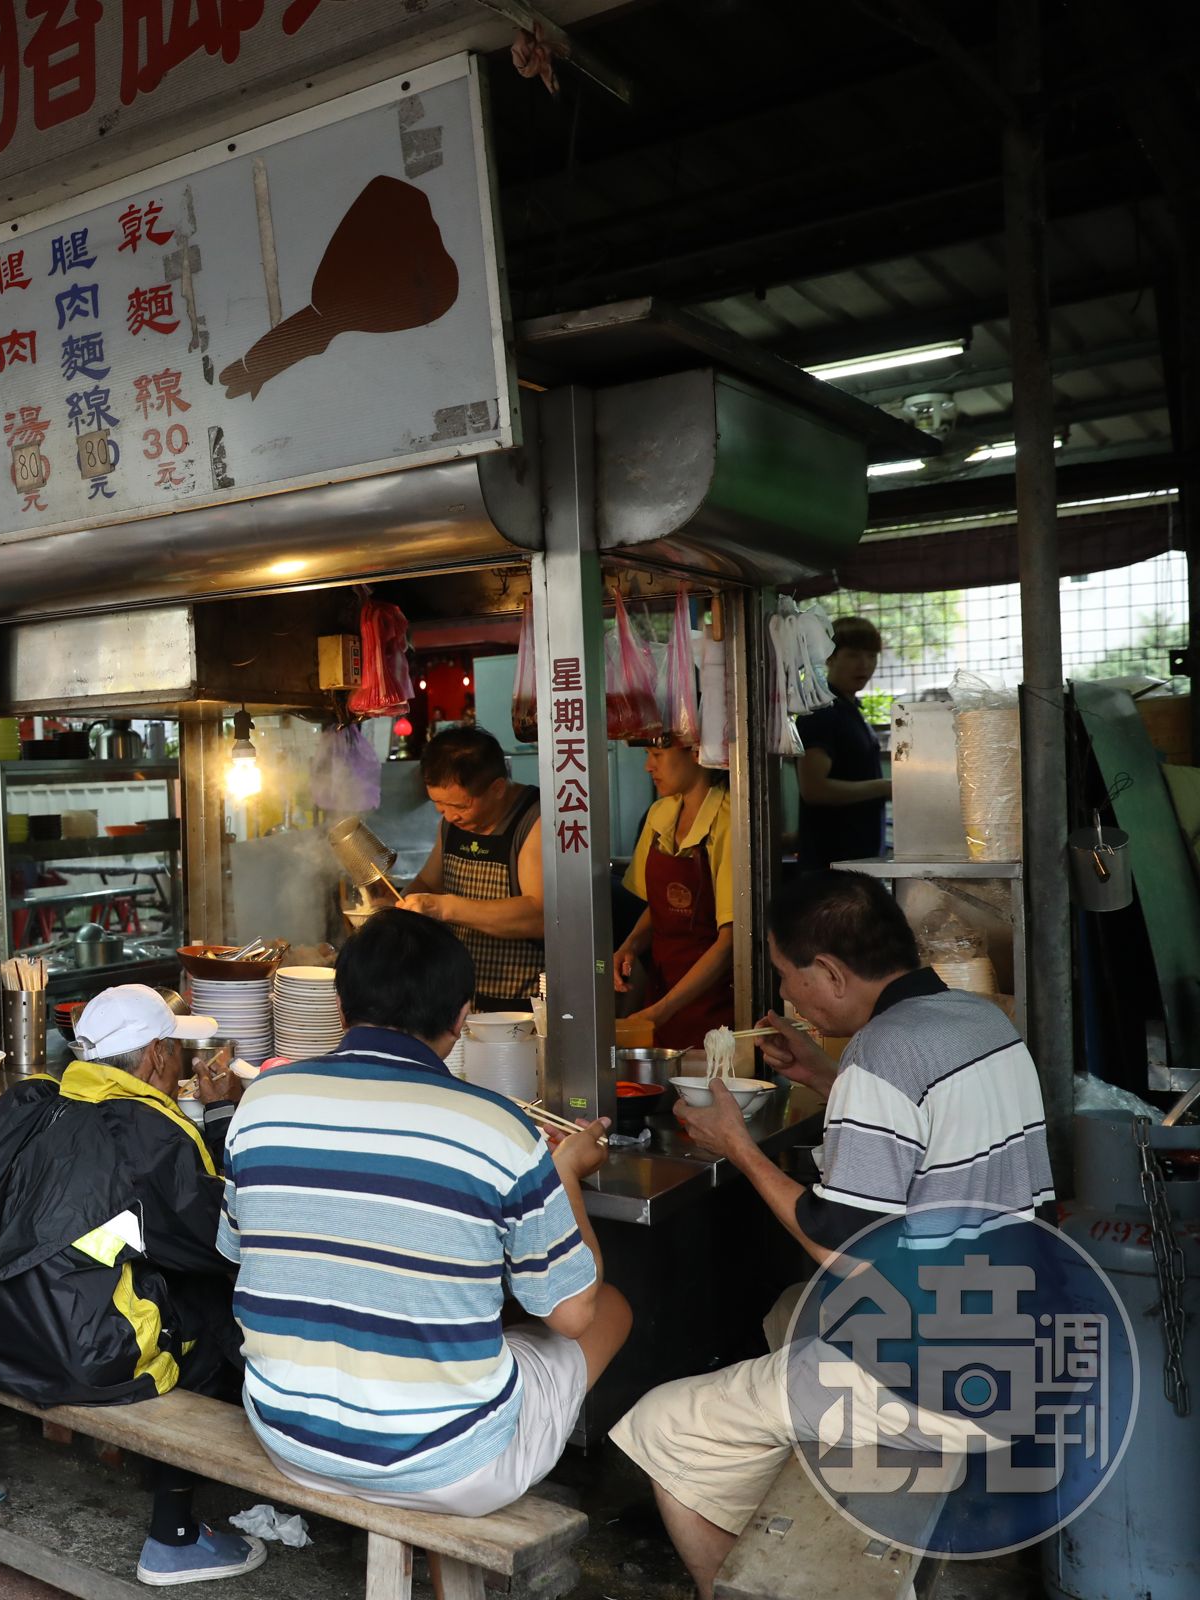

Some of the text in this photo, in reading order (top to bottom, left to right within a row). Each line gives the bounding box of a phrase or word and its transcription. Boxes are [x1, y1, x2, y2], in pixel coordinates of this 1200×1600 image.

[552, 657, 589, 853] 星期天公休
